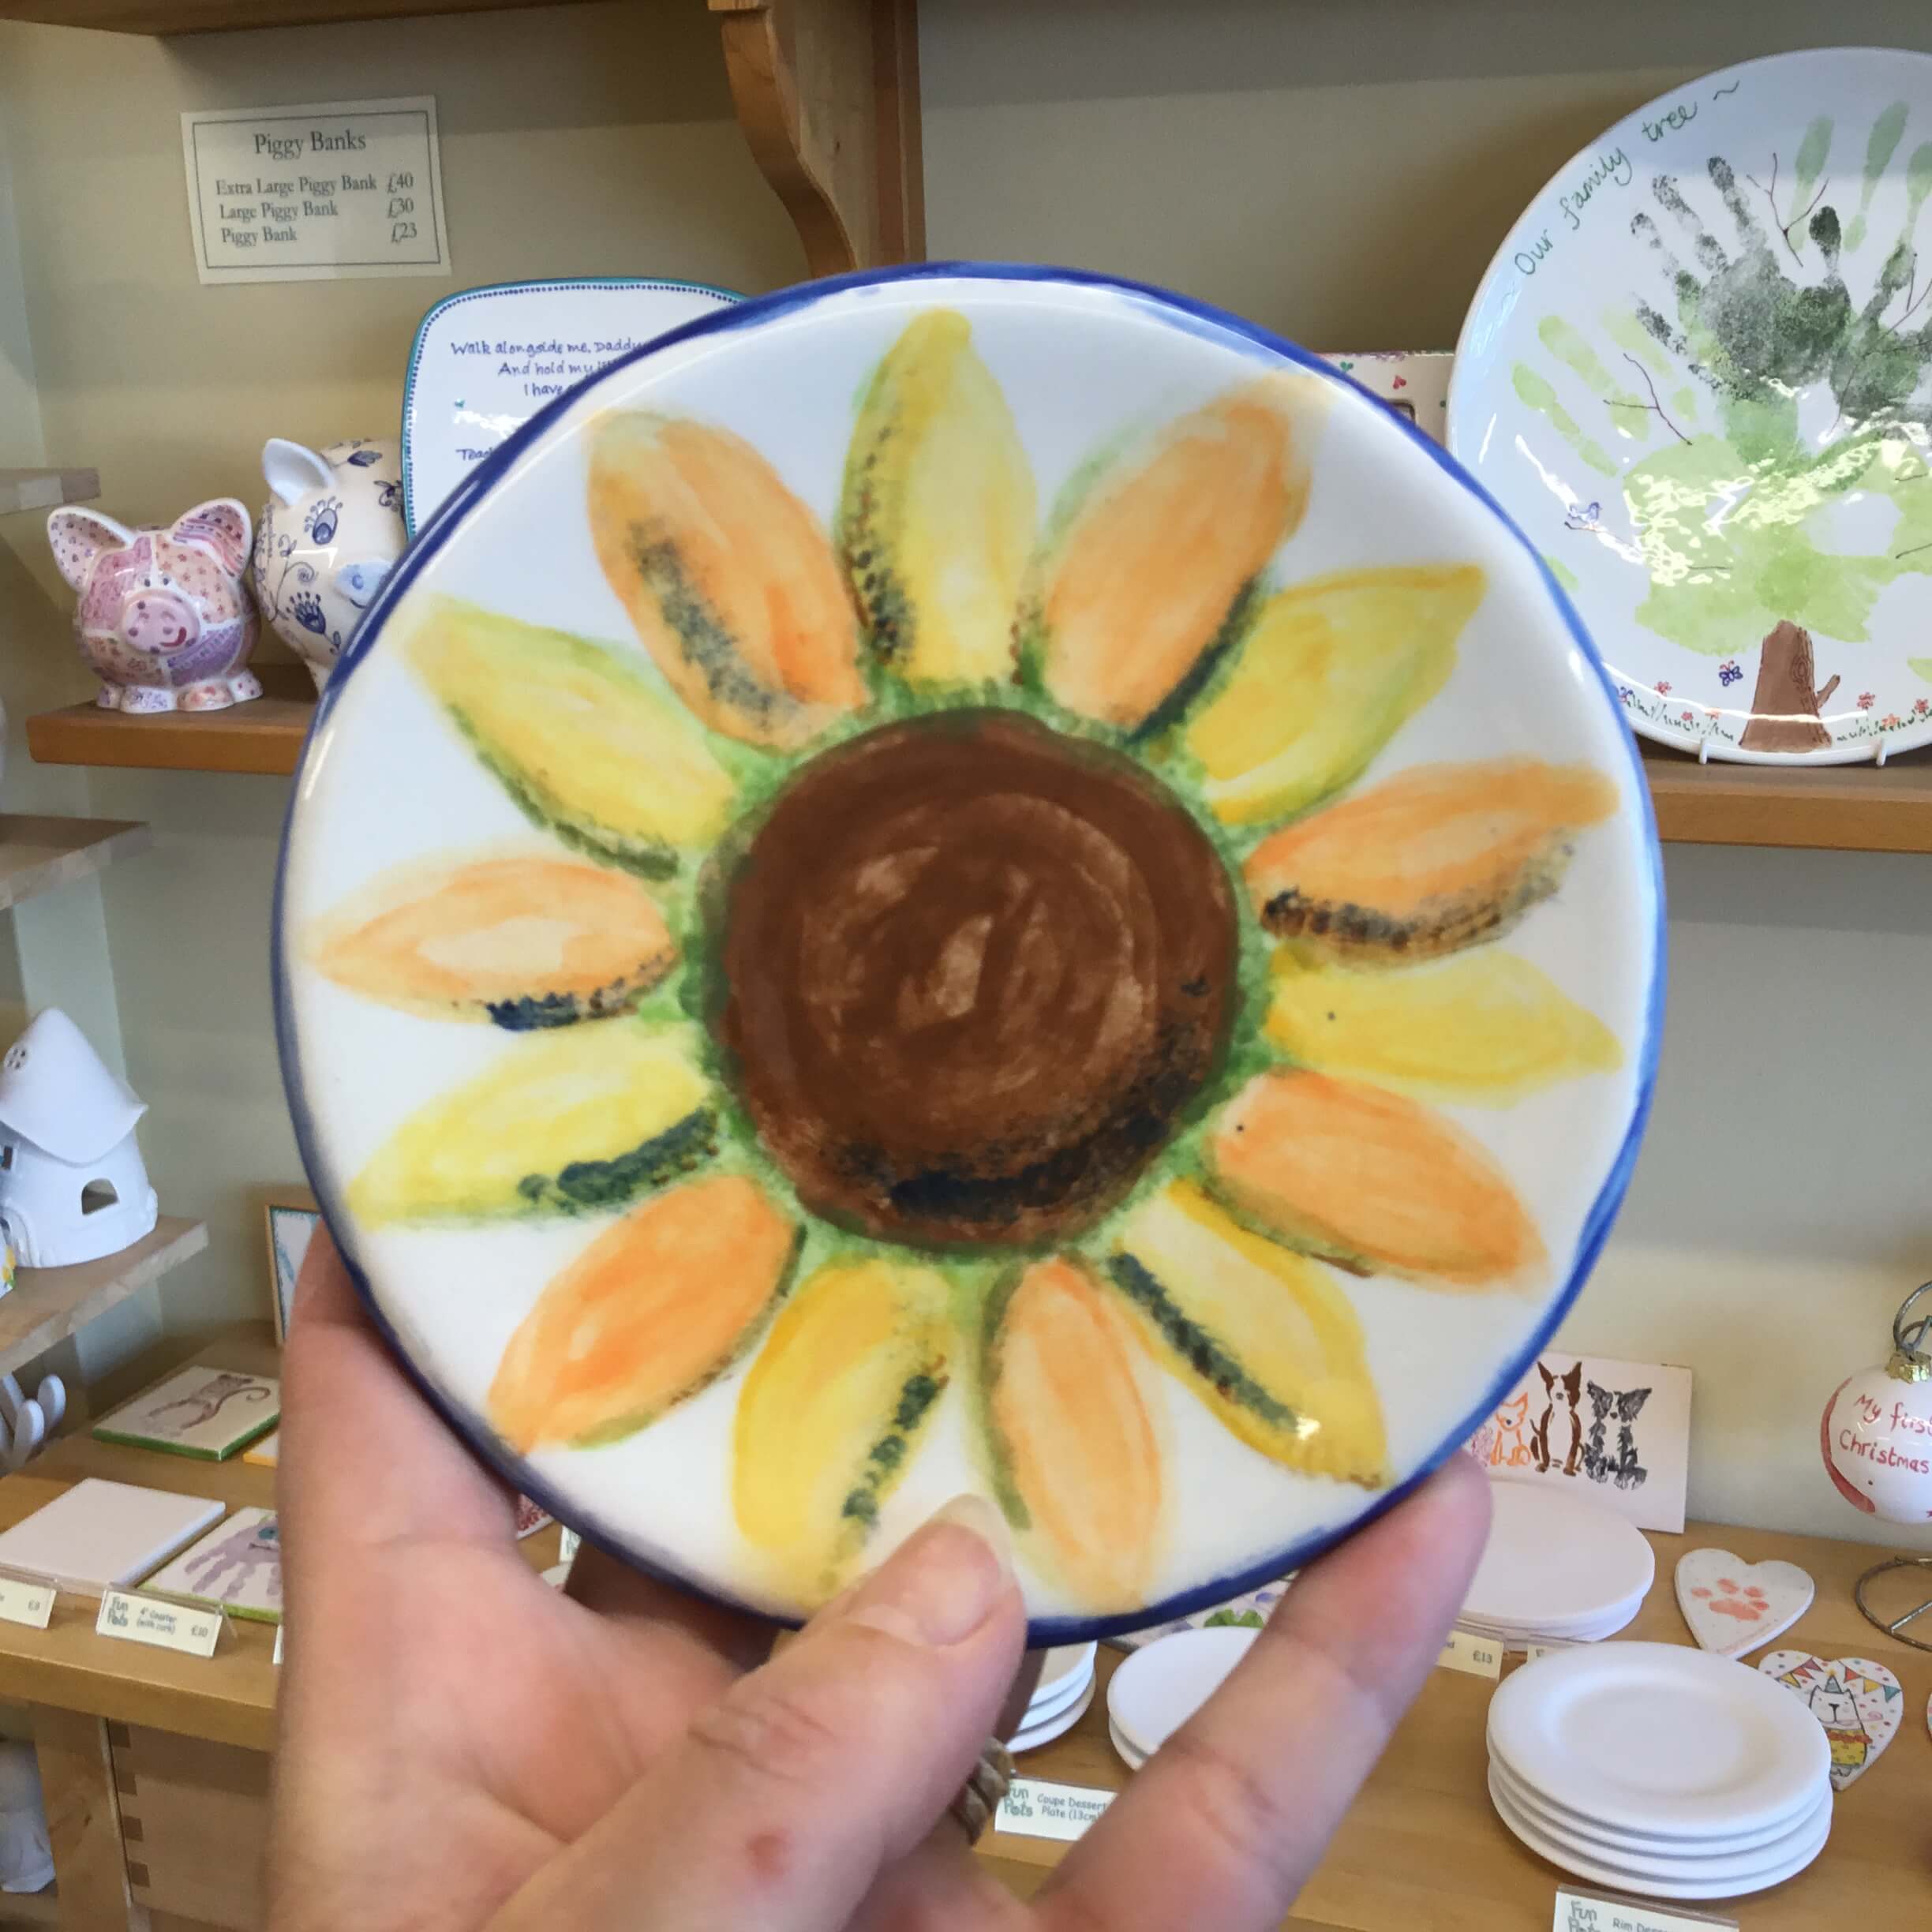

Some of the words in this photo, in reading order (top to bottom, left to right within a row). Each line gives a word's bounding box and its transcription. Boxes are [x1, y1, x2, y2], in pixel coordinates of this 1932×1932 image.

[253, 133, 304, 159] Piggy
[310, 129, 367, 152] Banks
[215, 179, 253, 195] Extra
[256, 178, 294, 197] Large
[298, 176, 337, 197] Piggy
[341, 173, 377, 191] Bank
[386, 172, 414, 193] £40
[1515, 229, 1553, 275] Our
[1559, 147, 1632, 230] family
[1642, 101, 1698, 142] tree
[219, 204, 256, 223] Large
[261, 202, 298, 222] Piggy
[303, 200, 339, 216] Bank
[388, 197, 414, 219] £30
[221, 227, 258, 247] Piggy
[262, 227, 298, 242] Bank
[391, 223, 417, 244] £23
[451, 340, 492, 355] Walk
[495, 339, 563, 358] alongside
[498, 361, 531, 376] And
[535, 361, 564, 376] hold
[532, 382, 563, 396] have
[455, 447, 493, 461] Teac
[1855, 1394, 1881, 1423] My
[1839, 1428, 1930, 1474] Christmas
[1004, 1798, 1033, 1817] Pots
[1037, 1793, 1065, 1807] Coupe
[1042, 1805, 1066, 1818] Plate
[1571, 1900, 1597, 1921] Fun
[1612, 1918, 1633, 1931] Rim
